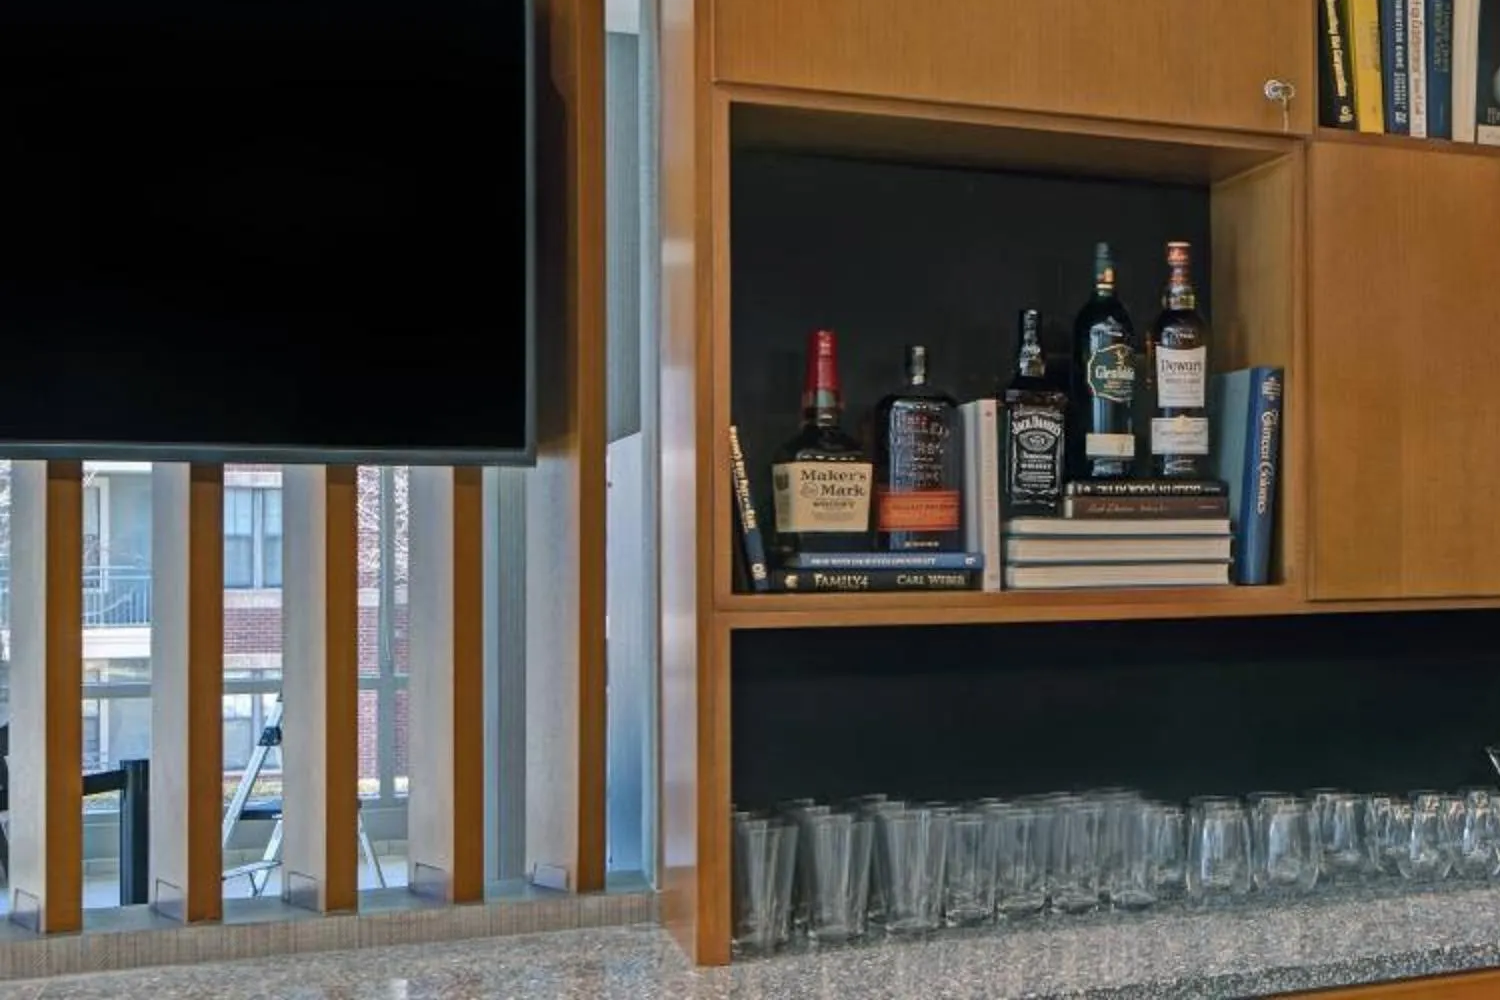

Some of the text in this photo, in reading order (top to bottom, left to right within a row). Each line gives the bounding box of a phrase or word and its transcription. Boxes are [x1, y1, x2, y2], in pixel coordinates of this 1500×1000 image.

[800, 469, 867, 481] Maker's
[821, 483, 864, 497] Mark
[897, 574, 925, 586] CARL
